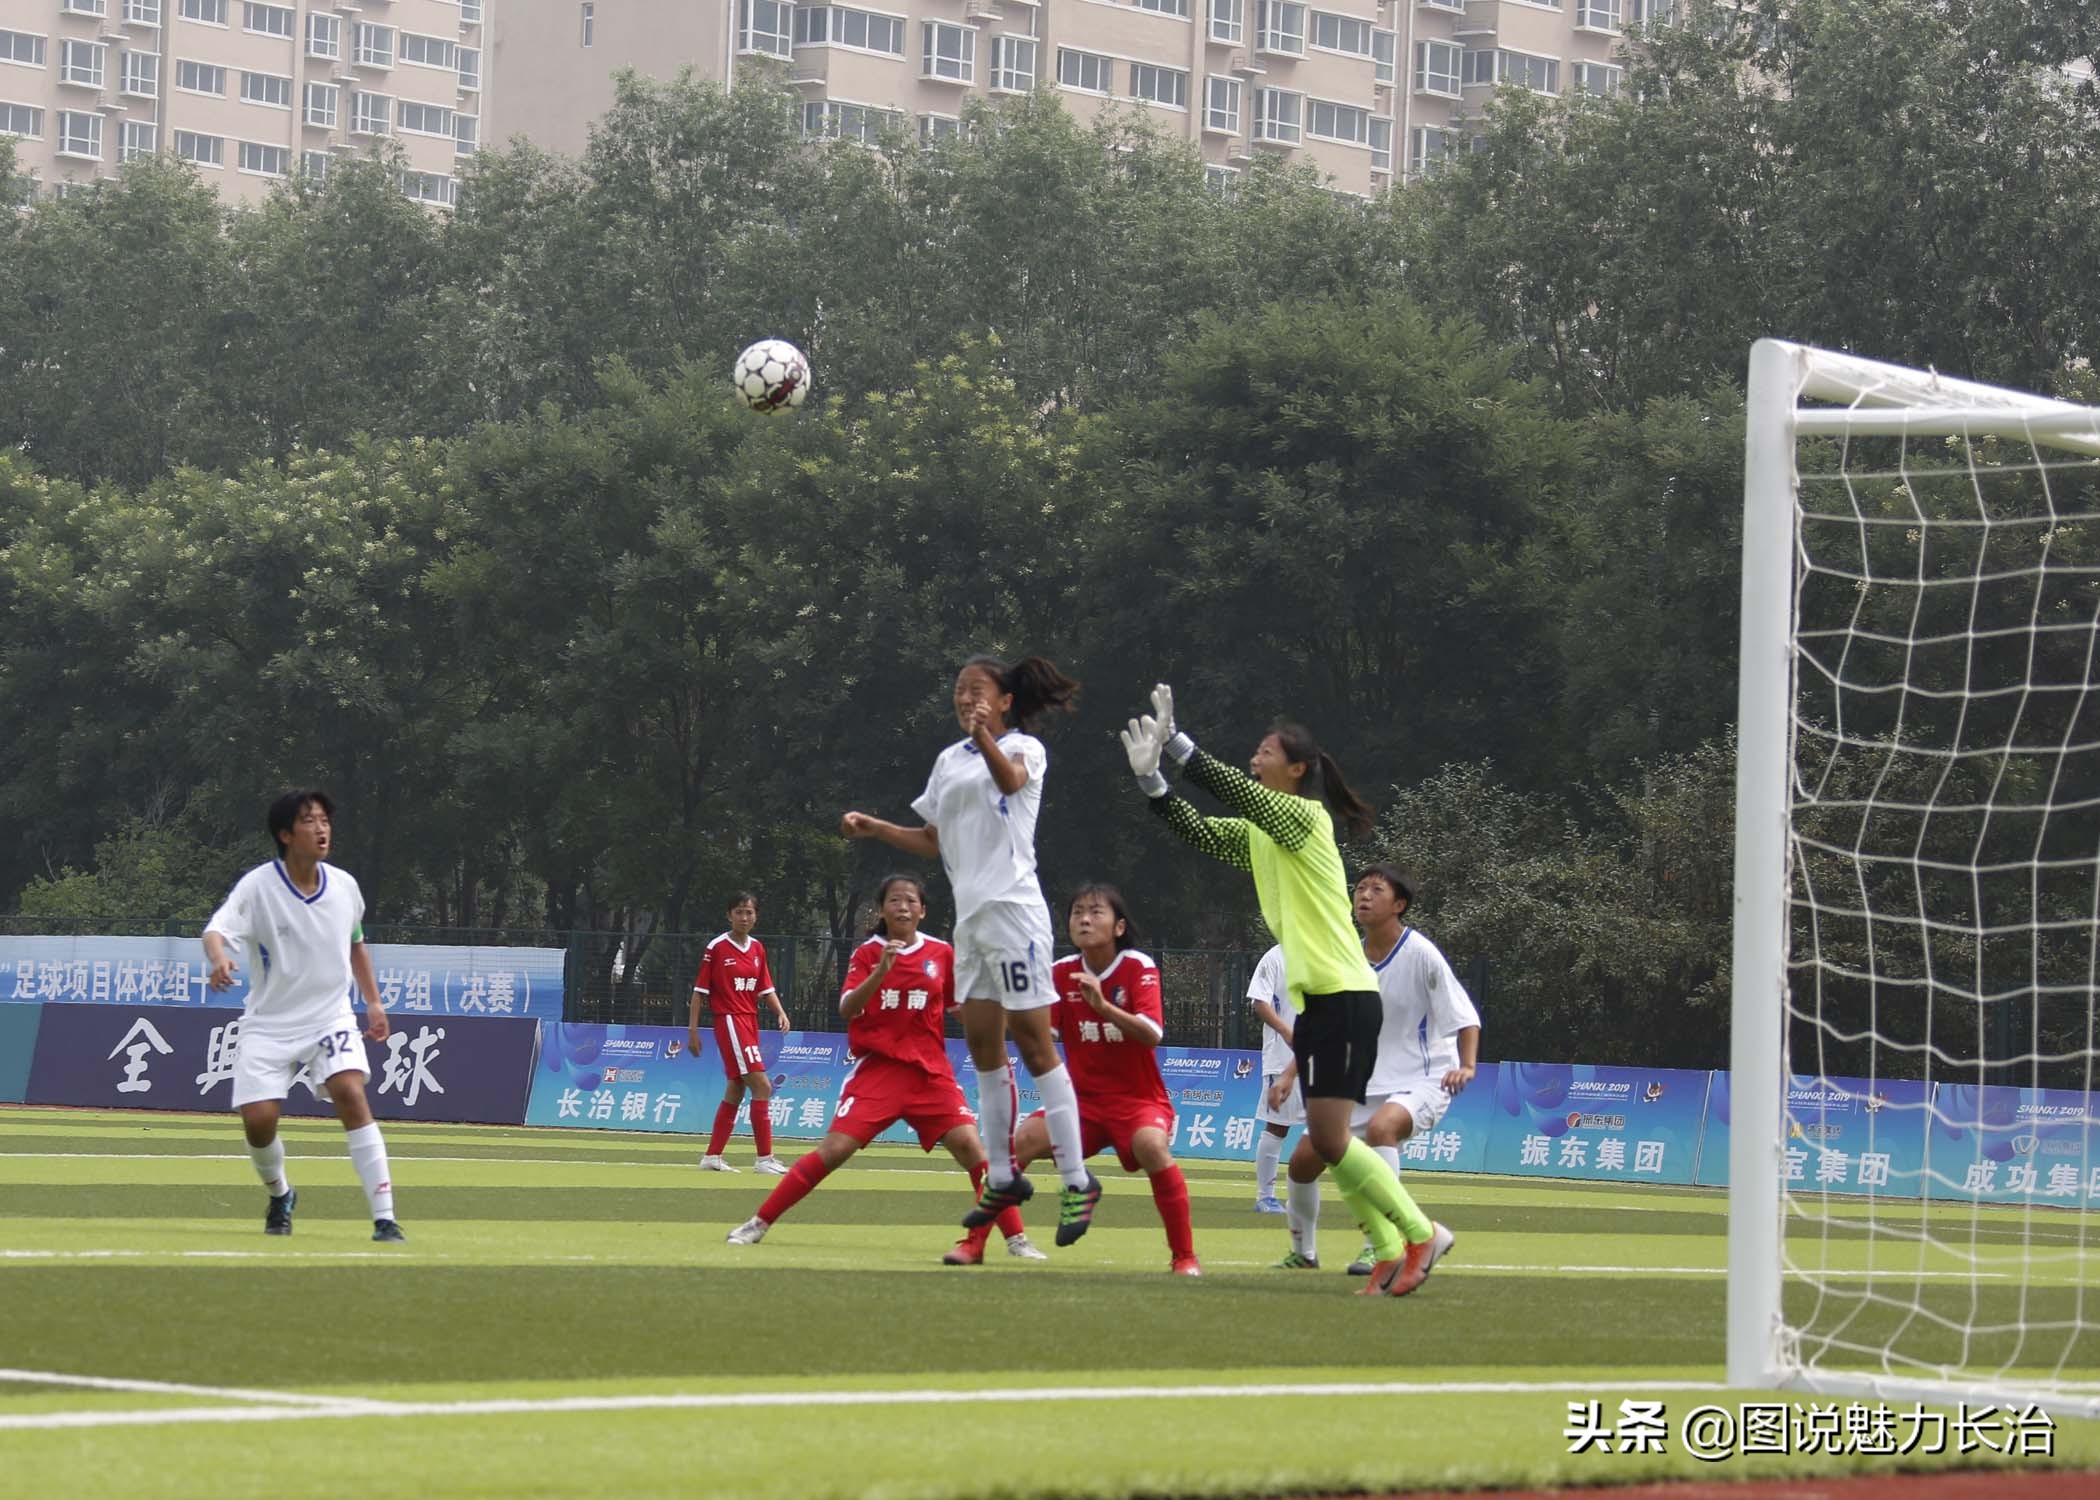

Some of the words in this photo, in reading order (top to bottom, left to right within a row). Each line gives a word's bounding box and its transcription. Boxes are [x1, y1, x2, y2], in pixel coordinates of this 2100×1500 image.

[734, 977, 758, 992] 海南
[1001, 961, 1029, 993] 16
[880, 988, 929, 1011] 海南
[1078, 1020, 1125, 1043] 海南
[635, 1041, 655, 1050] 2019
[744, 1045, 763, 1064] 15
[780, 1045, 811, 1056] SHANXI
[813, 1047, 833, 1056] 2019
[1163, 1057, 1198, 1068] SHANXI
[1200, 1059, 1222, 1069] 2019
[1307, 1055, 1315, 1086] 1
[1569, 1080, 1606, 1092] SHANXI
[1608, 1083, 1631, 1093] 2019
[1787, 1090, 1825, 1101] SHANXI
[1827, 1092, 1851, 1102] 2019
[556, 1088, 682, 1125] 长治银行
[2016, 1103, 2057, 1115] SHANXI
[2059, 1106, 2085, 1117] 2019
[1169, 1113, 1257, 1151] 长钢
[1519, 1133, 1666, 1175] 振东集团
[1778, 1146, 1891, 1187] 宝集团
